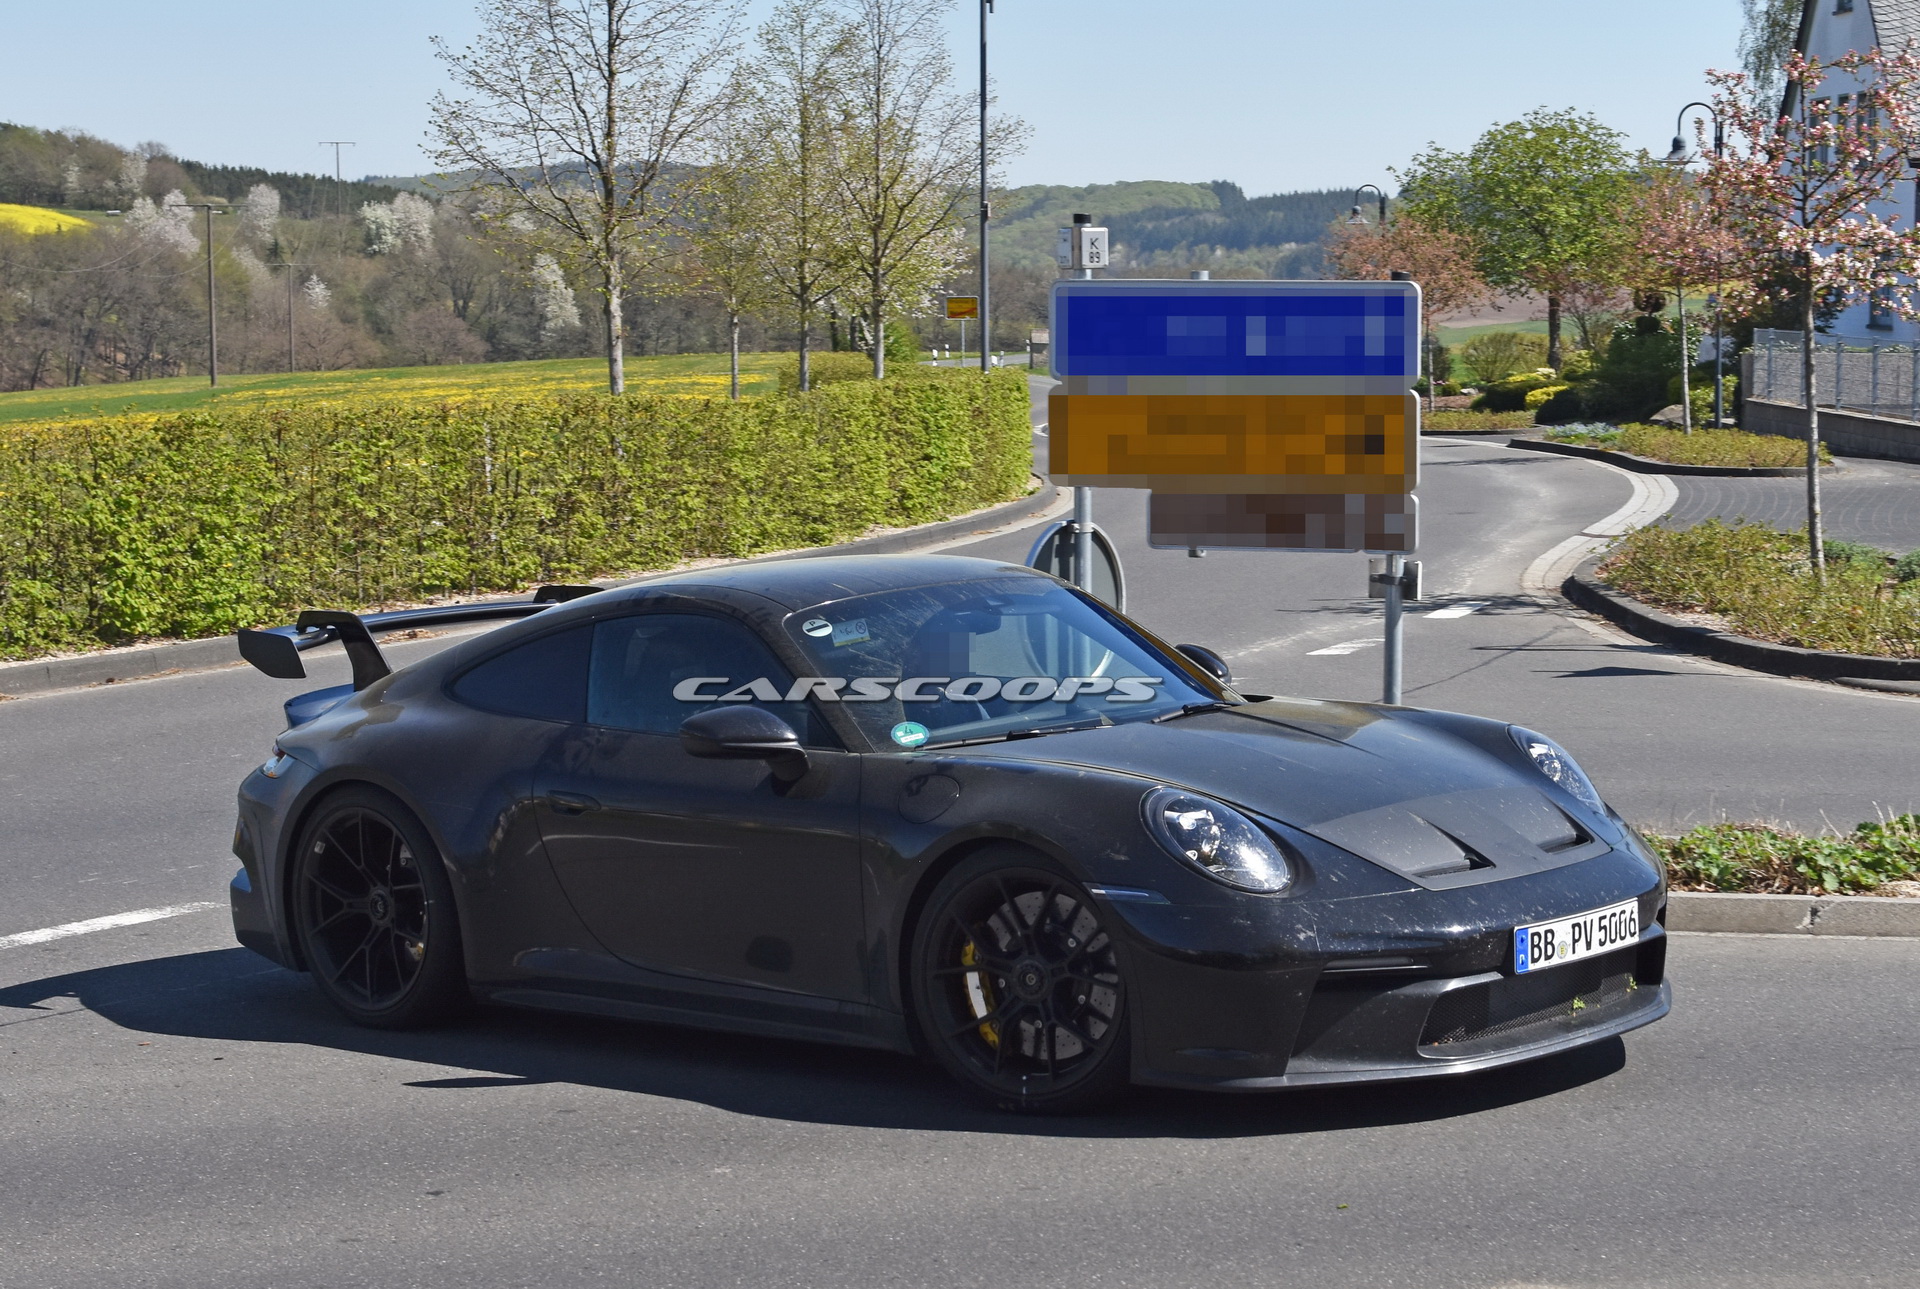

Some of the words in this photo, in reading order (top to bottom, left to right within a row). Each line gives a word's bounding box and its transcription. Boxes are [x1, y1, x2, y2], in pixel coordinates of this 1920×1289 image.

[1090, 237, 1099, 250] K
[1089, 251, 1101, 263] 89
[1530, 928, 1555, 964] BB
[1571, 918, 1593, 954] PV
